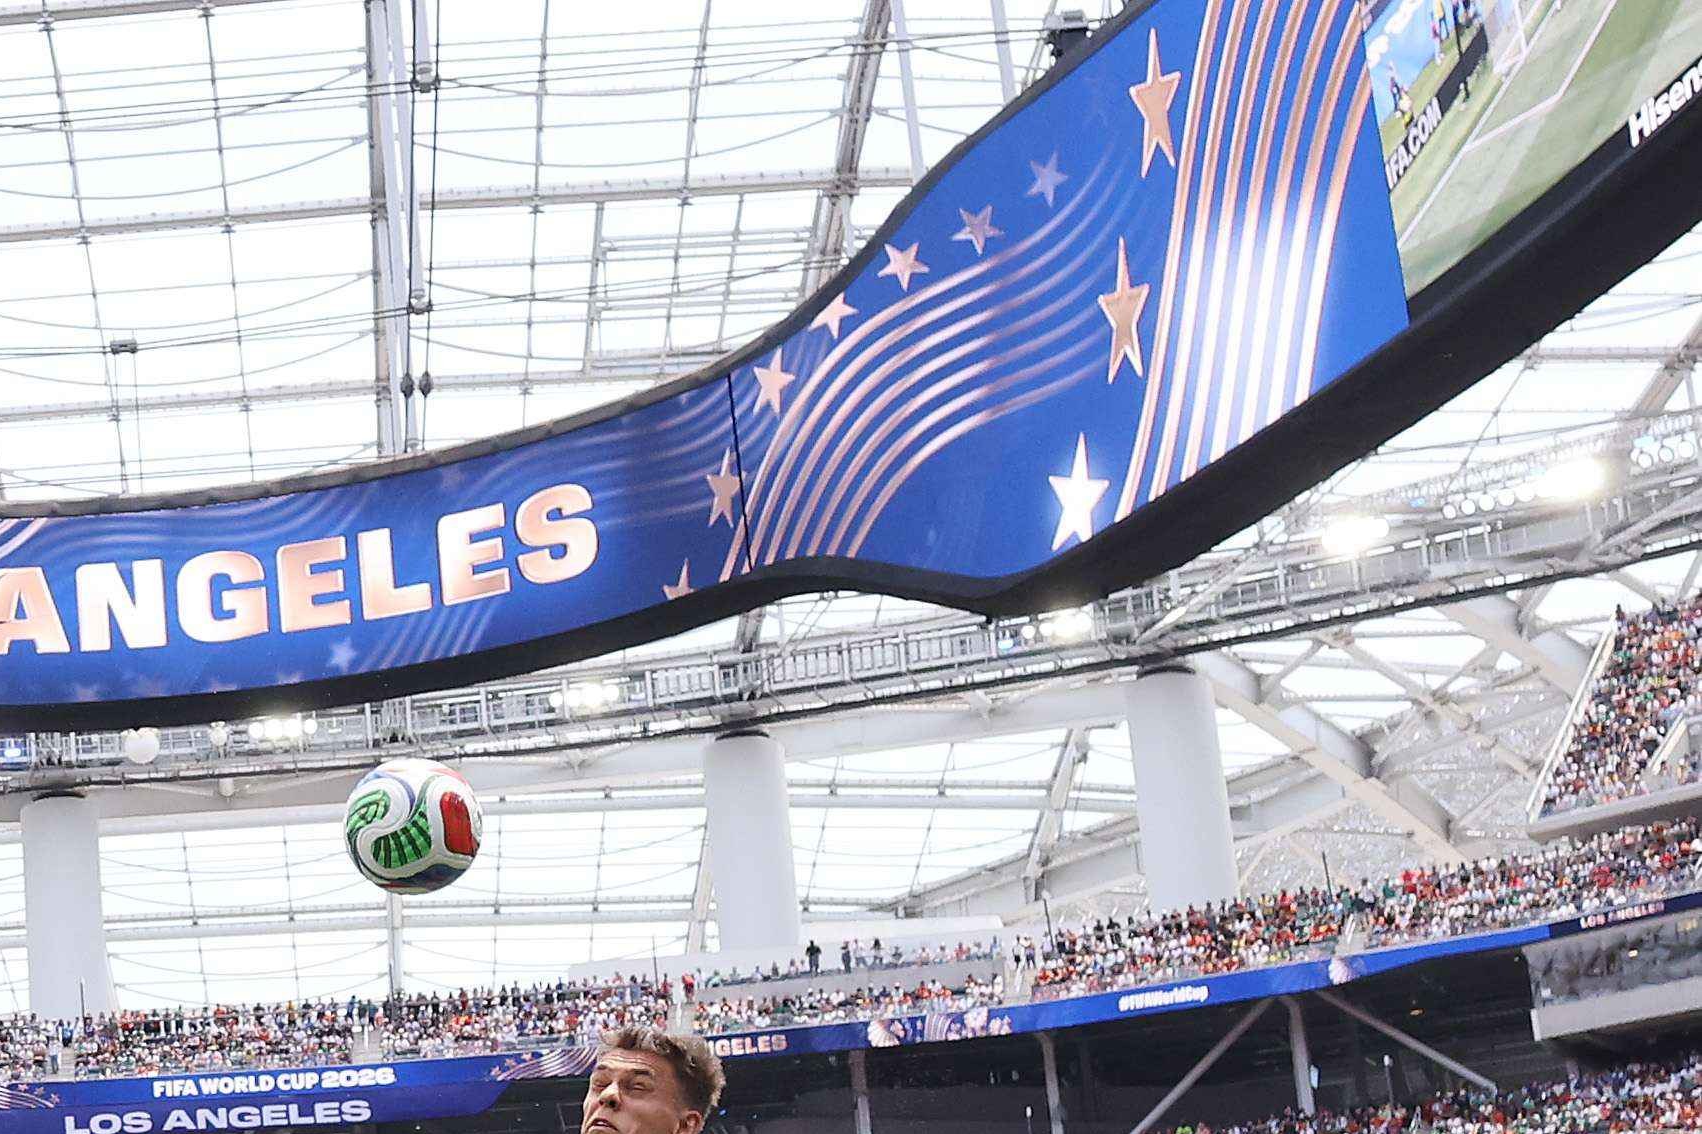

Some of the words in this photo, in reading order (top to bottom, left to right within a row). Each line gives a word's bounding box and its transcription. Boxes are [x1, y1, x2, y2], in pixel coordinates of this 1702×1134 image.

[1628, 59, 1702, 148] Hisen
[708, 1035, 788, 1056] GELES
[153, 1080, 199, 1098] FIFA
[199, 1074, 276, 1095] WORLD
[276, 1072, 320, 1091] CUP
[320, 1067, 396, 1088] 2026
[162, 1100, 373, 1132] ANGELES
